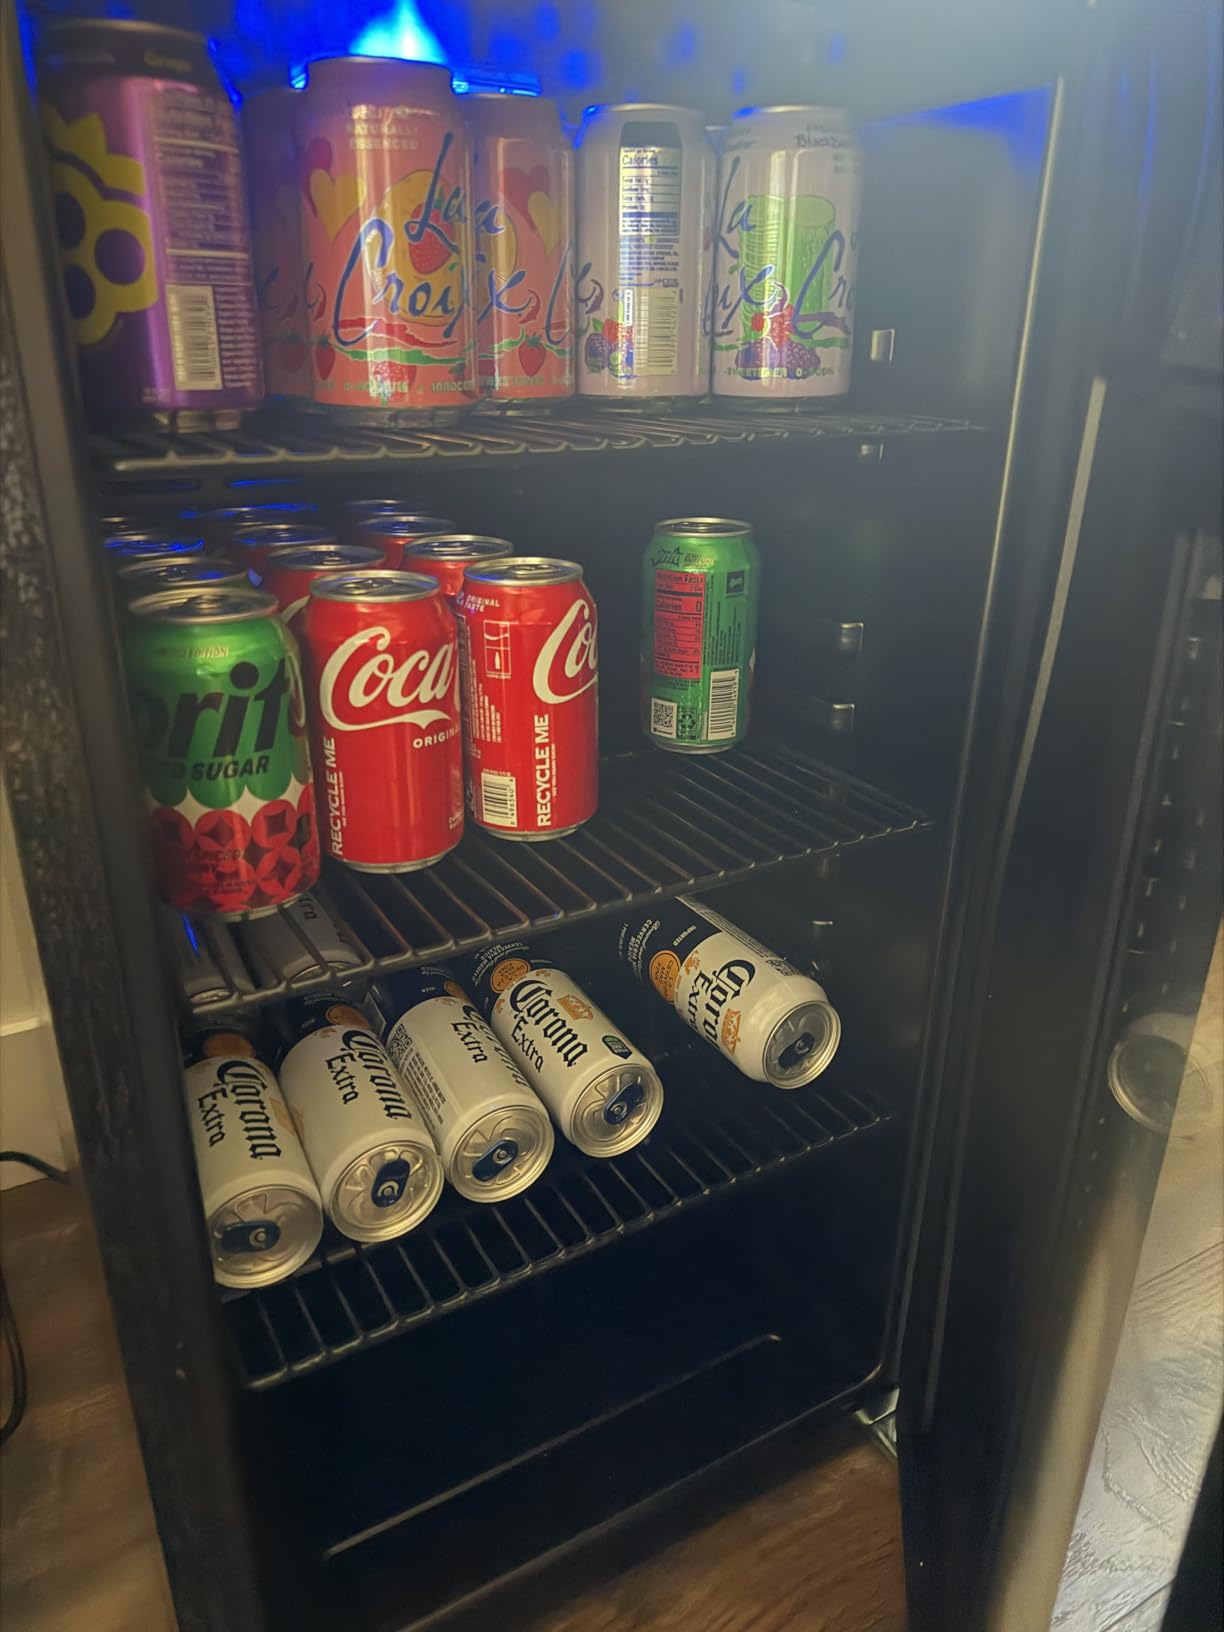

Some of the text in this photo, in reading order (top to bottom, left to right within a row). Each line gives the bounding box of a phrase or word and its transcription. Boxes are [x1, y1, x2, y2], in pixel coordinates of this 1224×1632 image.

[464, 600, 486, 614] TASTE
[466, 594, 501, 608] ORIGINAL
[319, 626, 453, 731] Coca
[191, 755, 270, 782] SUGAR
[322, 736, 338, 768] ME
[533, 713, 551, 827] RECYCLE ME
[325, 769, 344, 857] RECYCLE
[451, 1019, 489, 1064] Extra
[509, 978, 589, 1067] Corona
[511, 1009, 546, 1073] Extra
[324, 1044, 361, 1105] Extra
[341, 1029, 413, 1121] Corona
[196, 1081, 229, 1148] Extra
[215, 1059, 284, 1161] Corona
